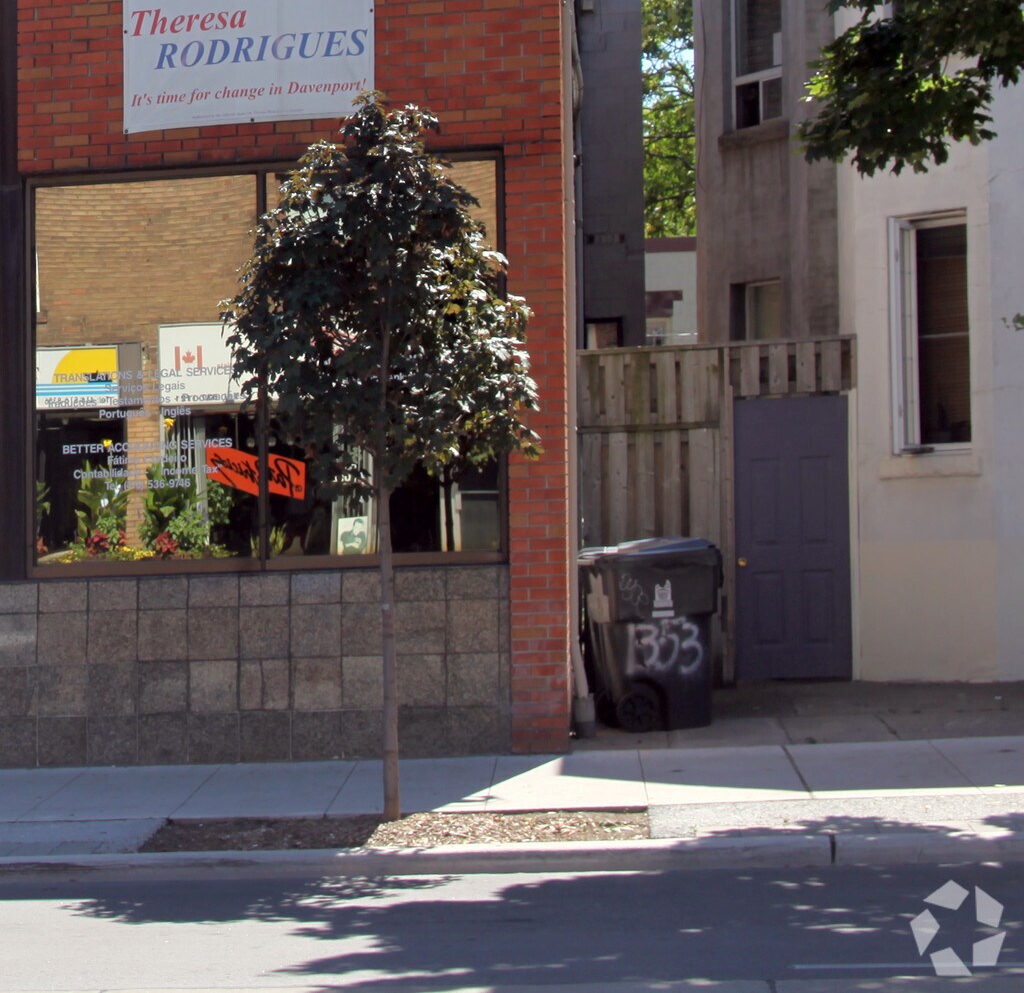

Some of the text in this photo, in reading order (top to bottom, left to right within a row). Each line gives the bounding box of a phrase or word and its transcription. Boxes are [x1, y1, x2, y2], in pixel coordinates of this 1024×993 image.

[130, 8, 247, 37] Theresa
[154, 28, 368, 71] RODRIGUES
[131, 78, 368, 108] It's time for change in Davenport!
[54, 372, 132, 383] TRANSLATIONS
[152, 369, 182, 379] LEGAL
[186, 366, 235, 377] SERVICES
[161, 406, 191, 418] Inglês
[62, 443, 104, 455] BETTER
[181, 438, 233, 450] SERVICES
[147, 478, 191, 490] 536-9746
